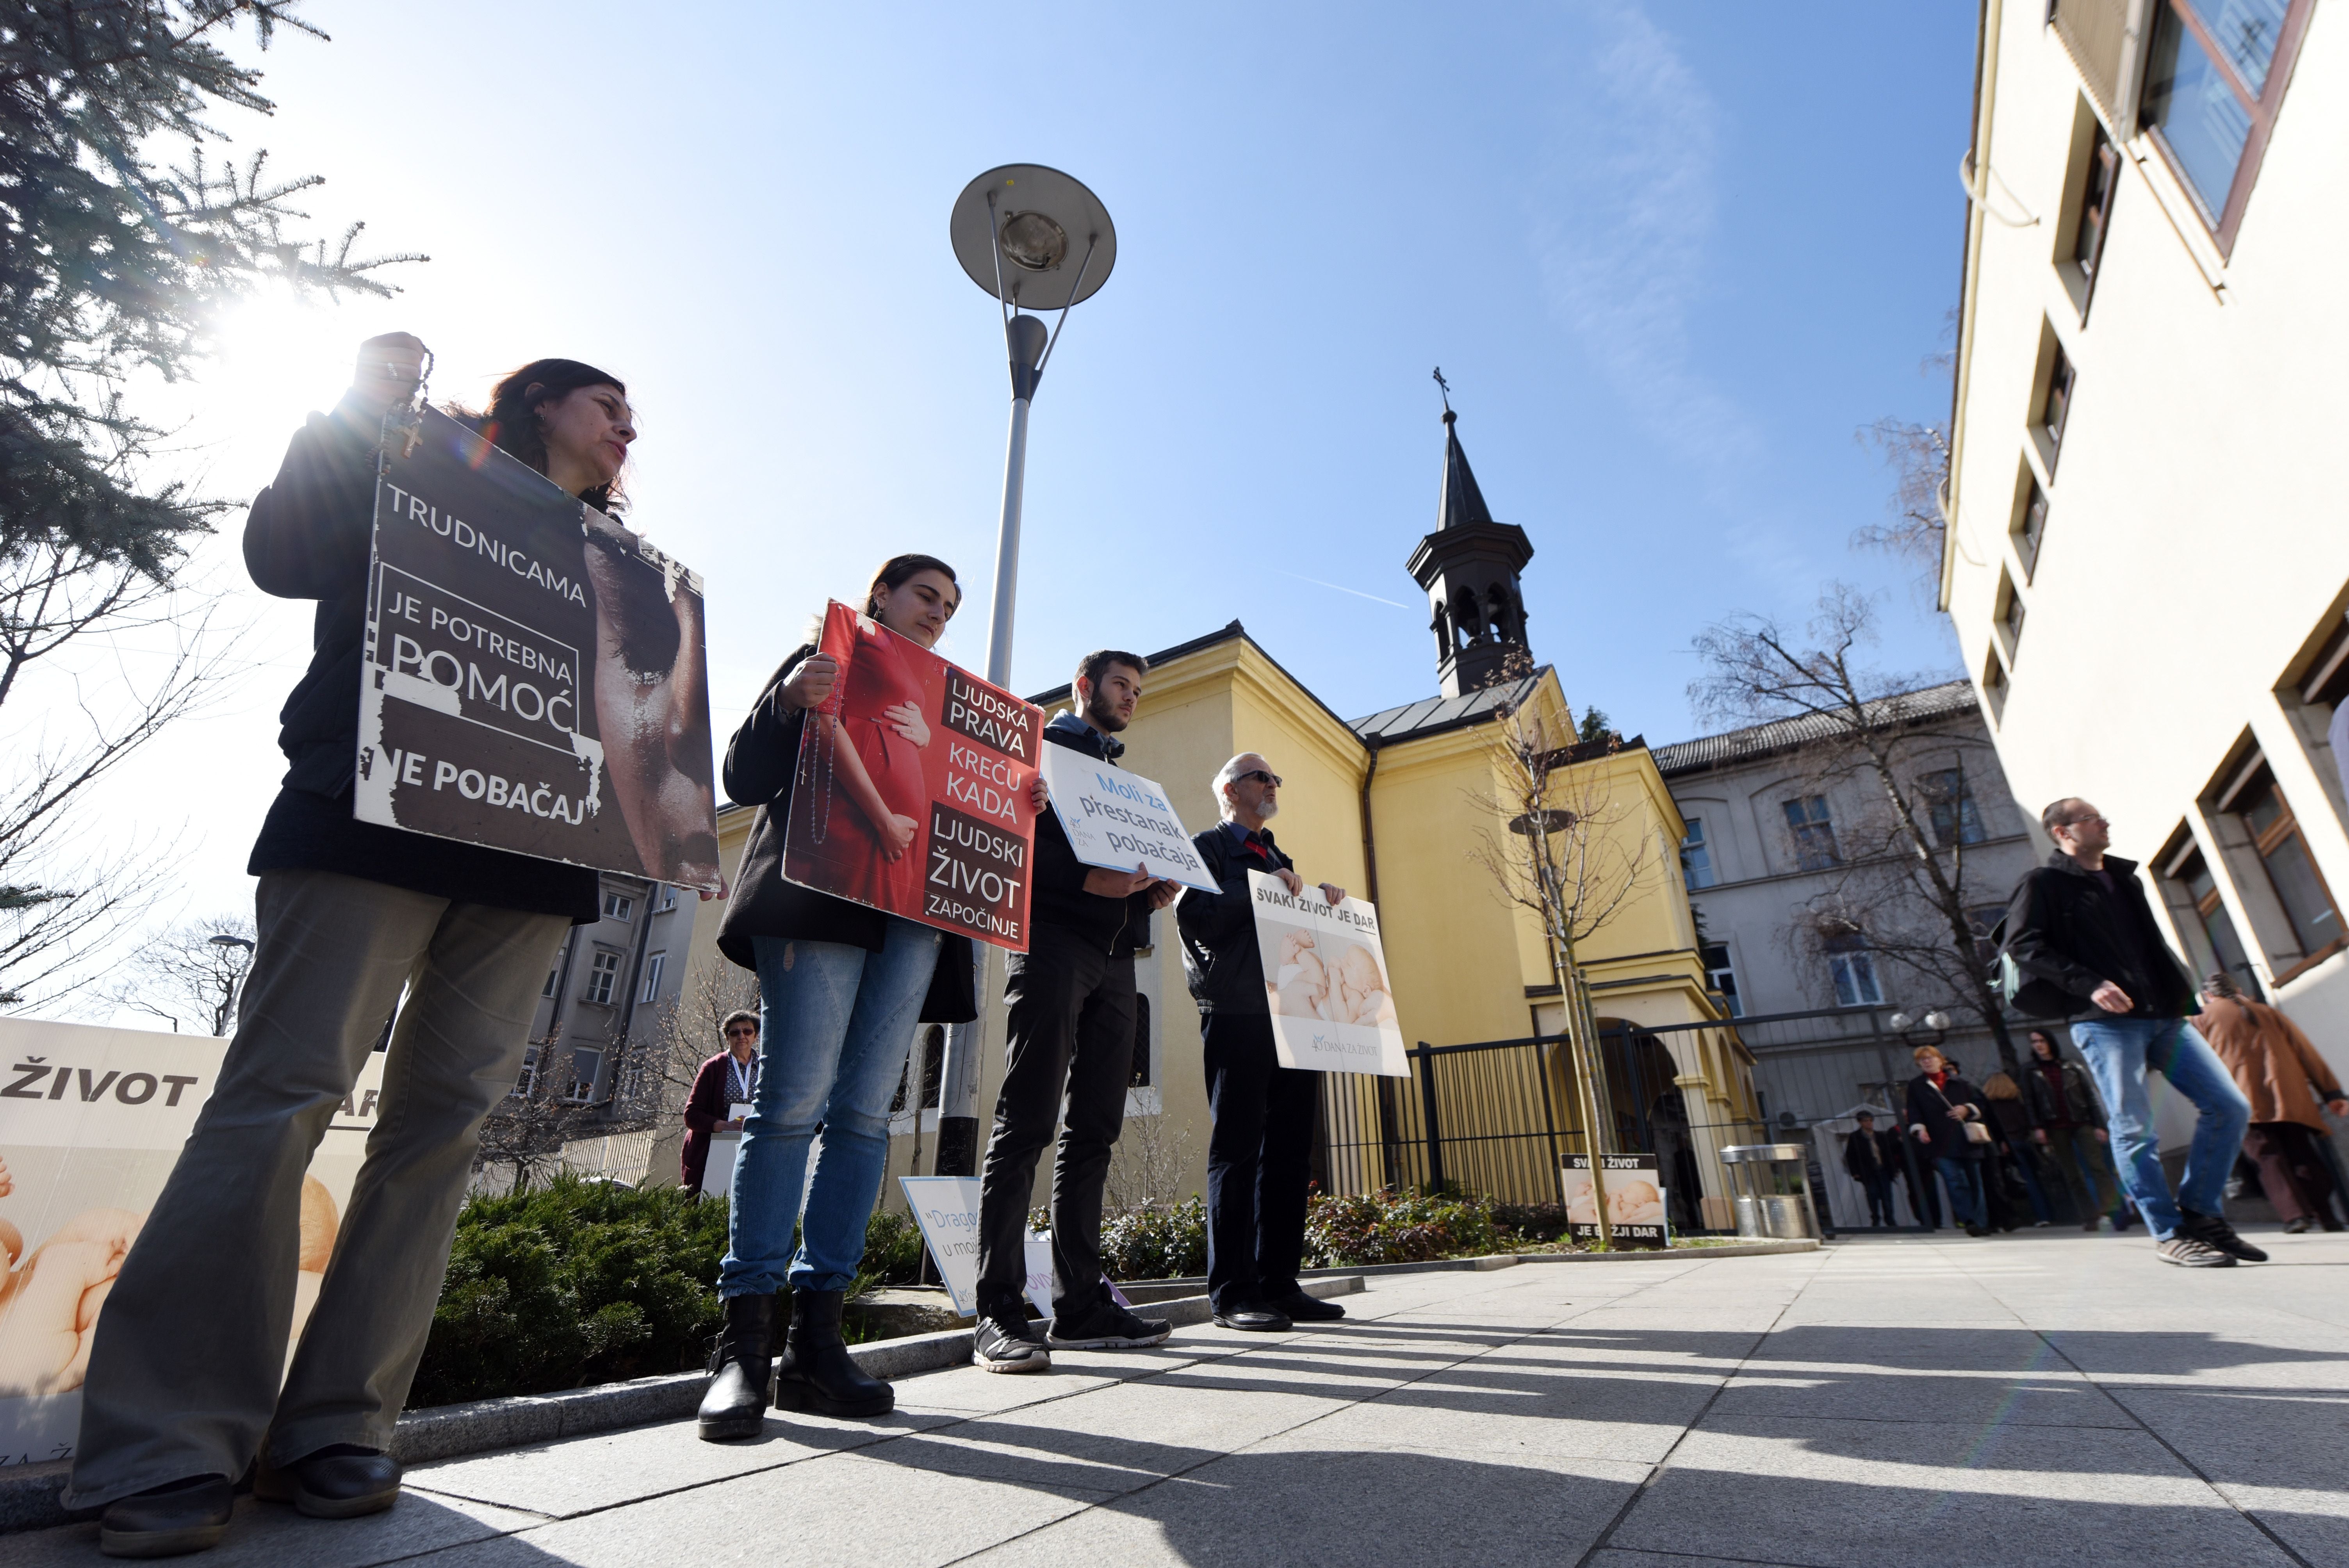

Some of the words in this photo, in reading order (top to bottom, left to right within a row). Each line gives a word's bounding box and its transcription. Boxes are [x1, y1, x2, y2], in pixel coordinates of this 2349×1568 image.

[387, 484, 586, 608] TRUDNICAMA
[389, 592, 421, 623] JE
[432, 607, 572, 685] POTREBNA
[393, 633, 573, 733] POMOĆ
[952, 679, 1028, 732] LJUDSKA
[950, 702, 1025, 758] PRAVA
[368, 742, 426, 786] NE
[434, 760, 585, 825] POBAČAJ
[949, 742, 1020, 791] KREĆU
[947, 772, 1016, 824] KADA
[1095, 773, 1144, 804] Moli
[1144, 794, 1169, 813] za
[935, 813, 1023, 868] LJUDSKI
[1070, 820, 1080, 828] 40
[1072, 829, 1096, 841] DANA
[1079, 796, 1185, 841] prestanak
[1076, 838, 1089, 847] ZA
[1106, 831, 1201, 871] pobačaja
[930, 846, 1021, 909] ŽIVOT
[929, 896, 1018, 939] ZAPOČINJE
[1256, 887, 1296, 909] SVAKI
[1299, 896, 1333, 918] ŽIVOT
[1337, 909, 1351, 923] JE
[1353, 913, 1375, 929] DAR
[1312, 1039, 1322, 1051] 40
[1324, 1041, 1347, 1053] DANA
[1347, 1043, 1358, 1054] ZA
[1357, 1043, 1378, 1056] ŽIVOT
[0, 1056, 198, 1107] ŽIVOT
[1607, 1156, 1639, 1168] ŽIVOT
[942, 1244, 952, 1256] u
[1577, 1226, 1592, 1235] JE
[1594, 1225, 1630, 1237] BŽJI
[1633, 1227, 1658, 1237] DAR
